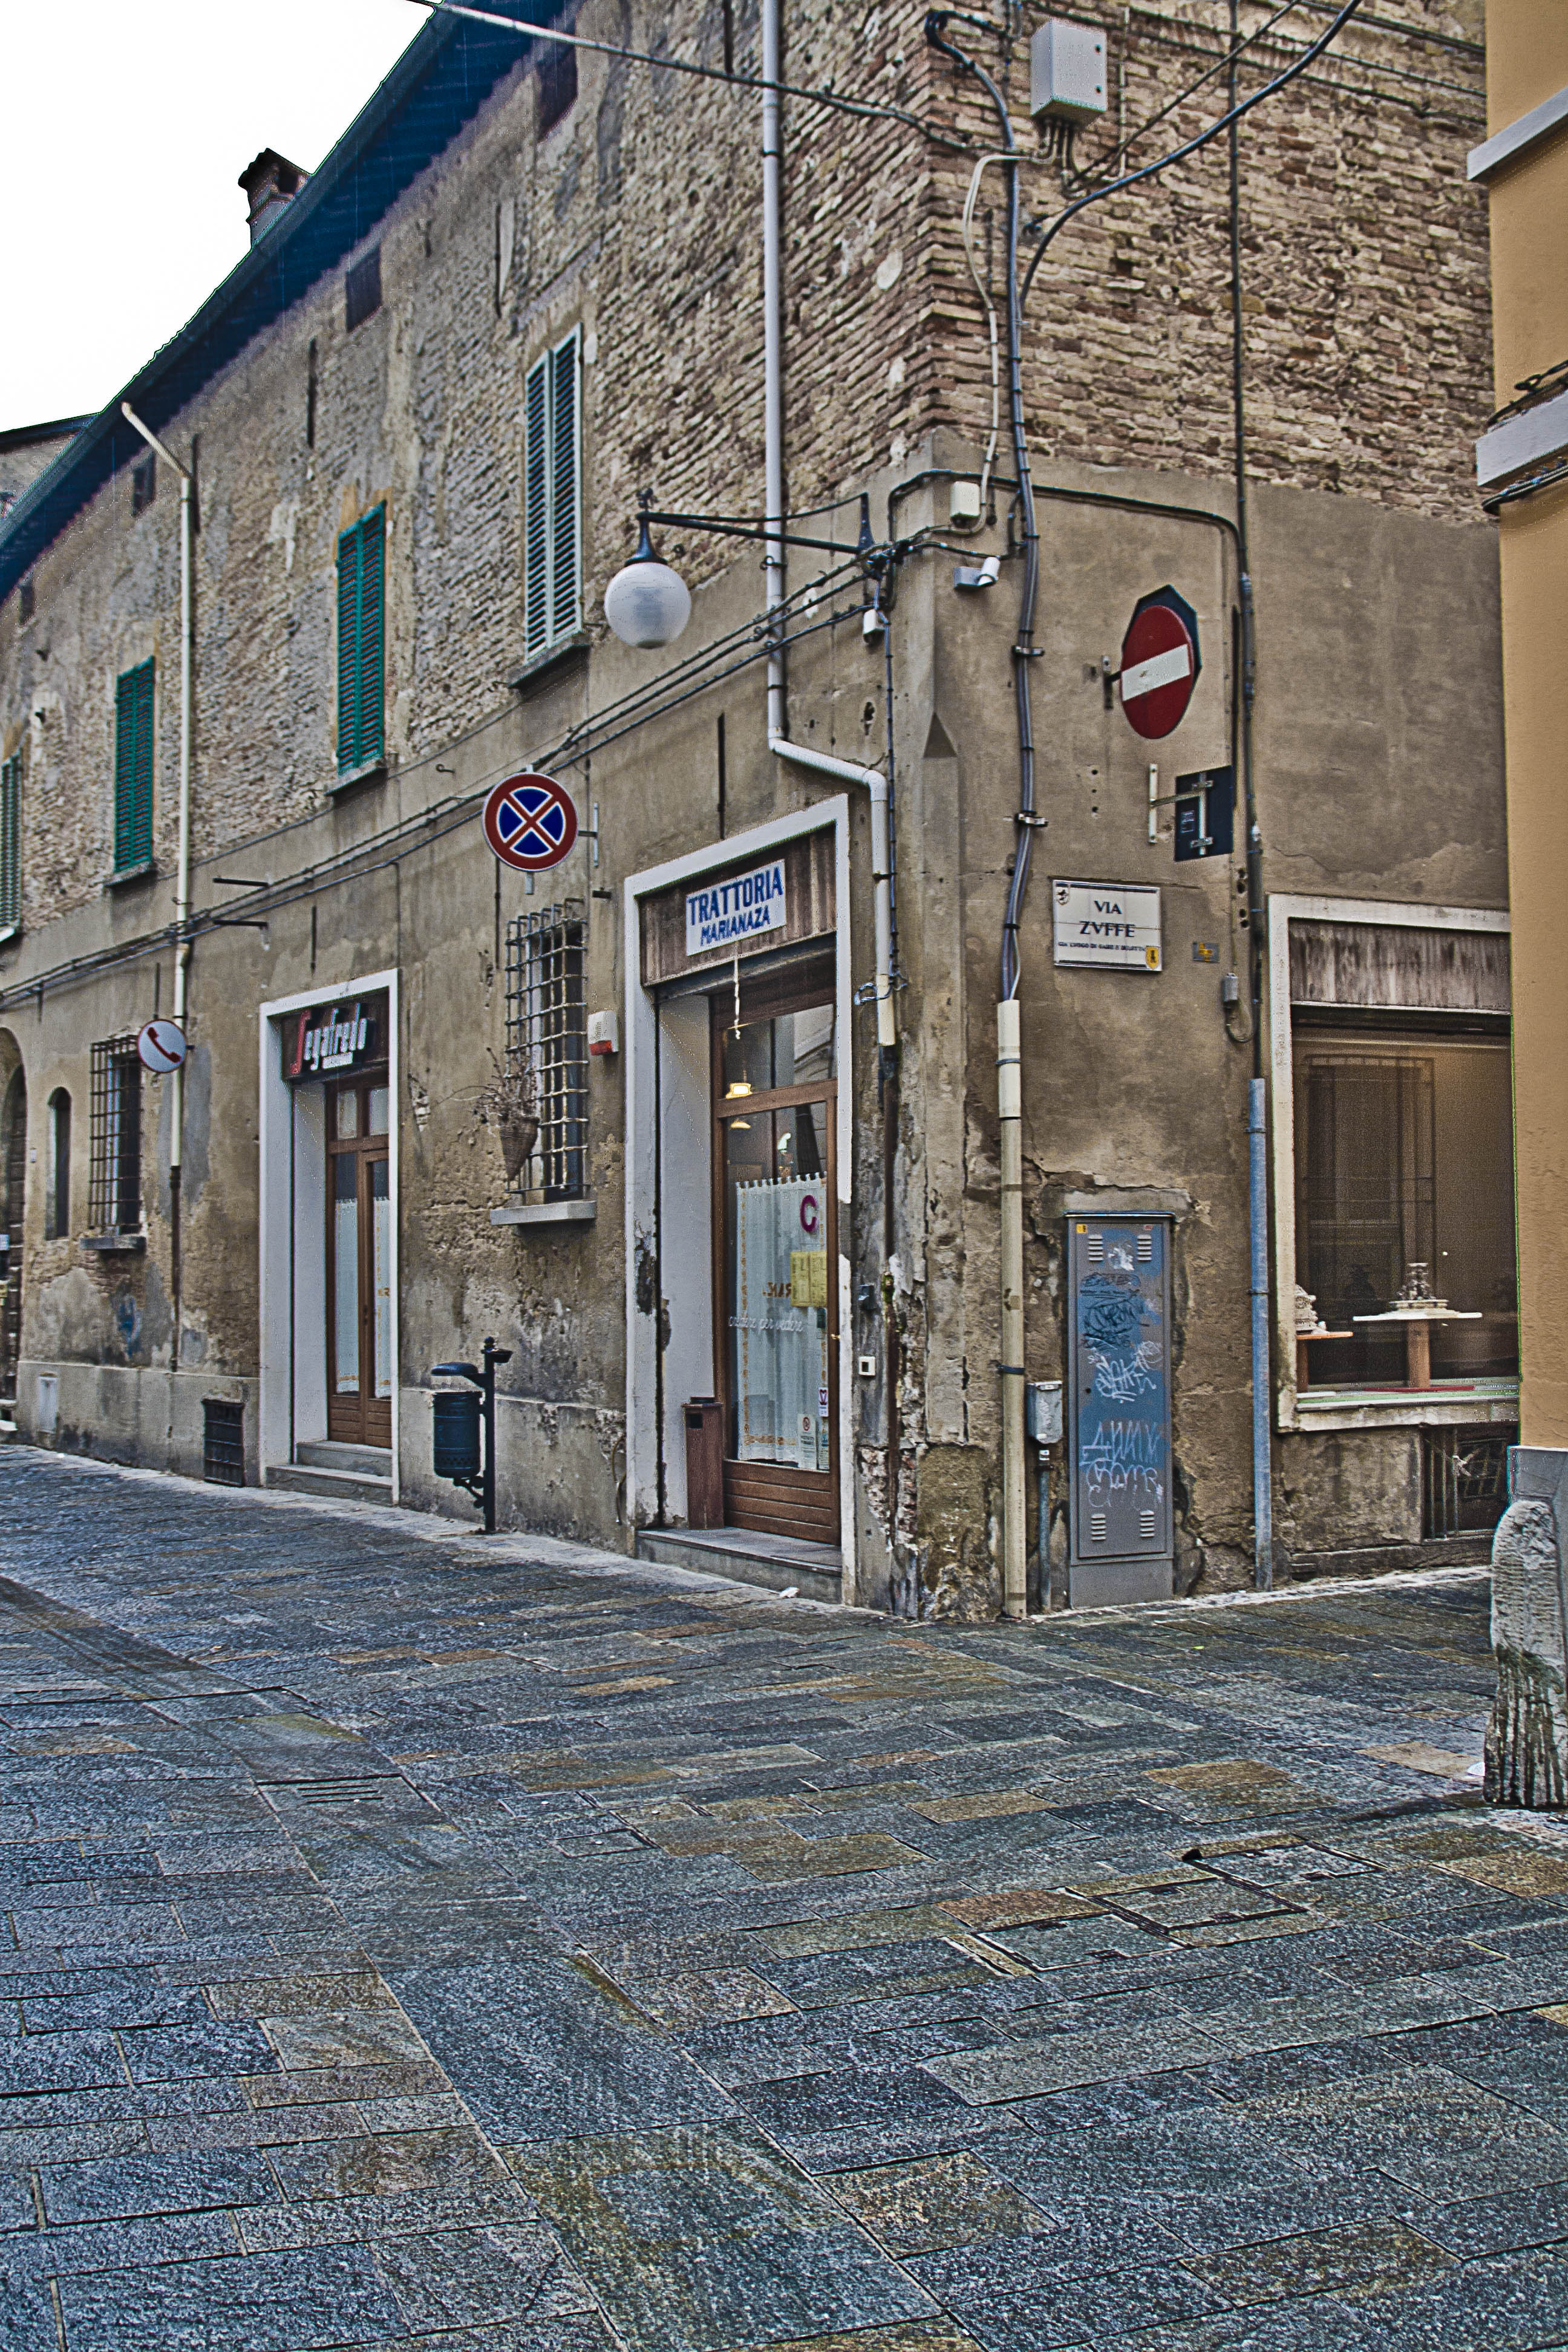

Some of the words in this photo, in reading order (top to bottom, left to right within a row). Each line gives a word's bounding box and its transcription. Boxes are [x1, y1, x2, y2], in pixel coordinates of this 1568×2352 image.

[688, 867, 783, 926] TRATTORIA
[1093, 900, 1123, 915] VIA
[700, 905, 771, 947] MARIANAZA
